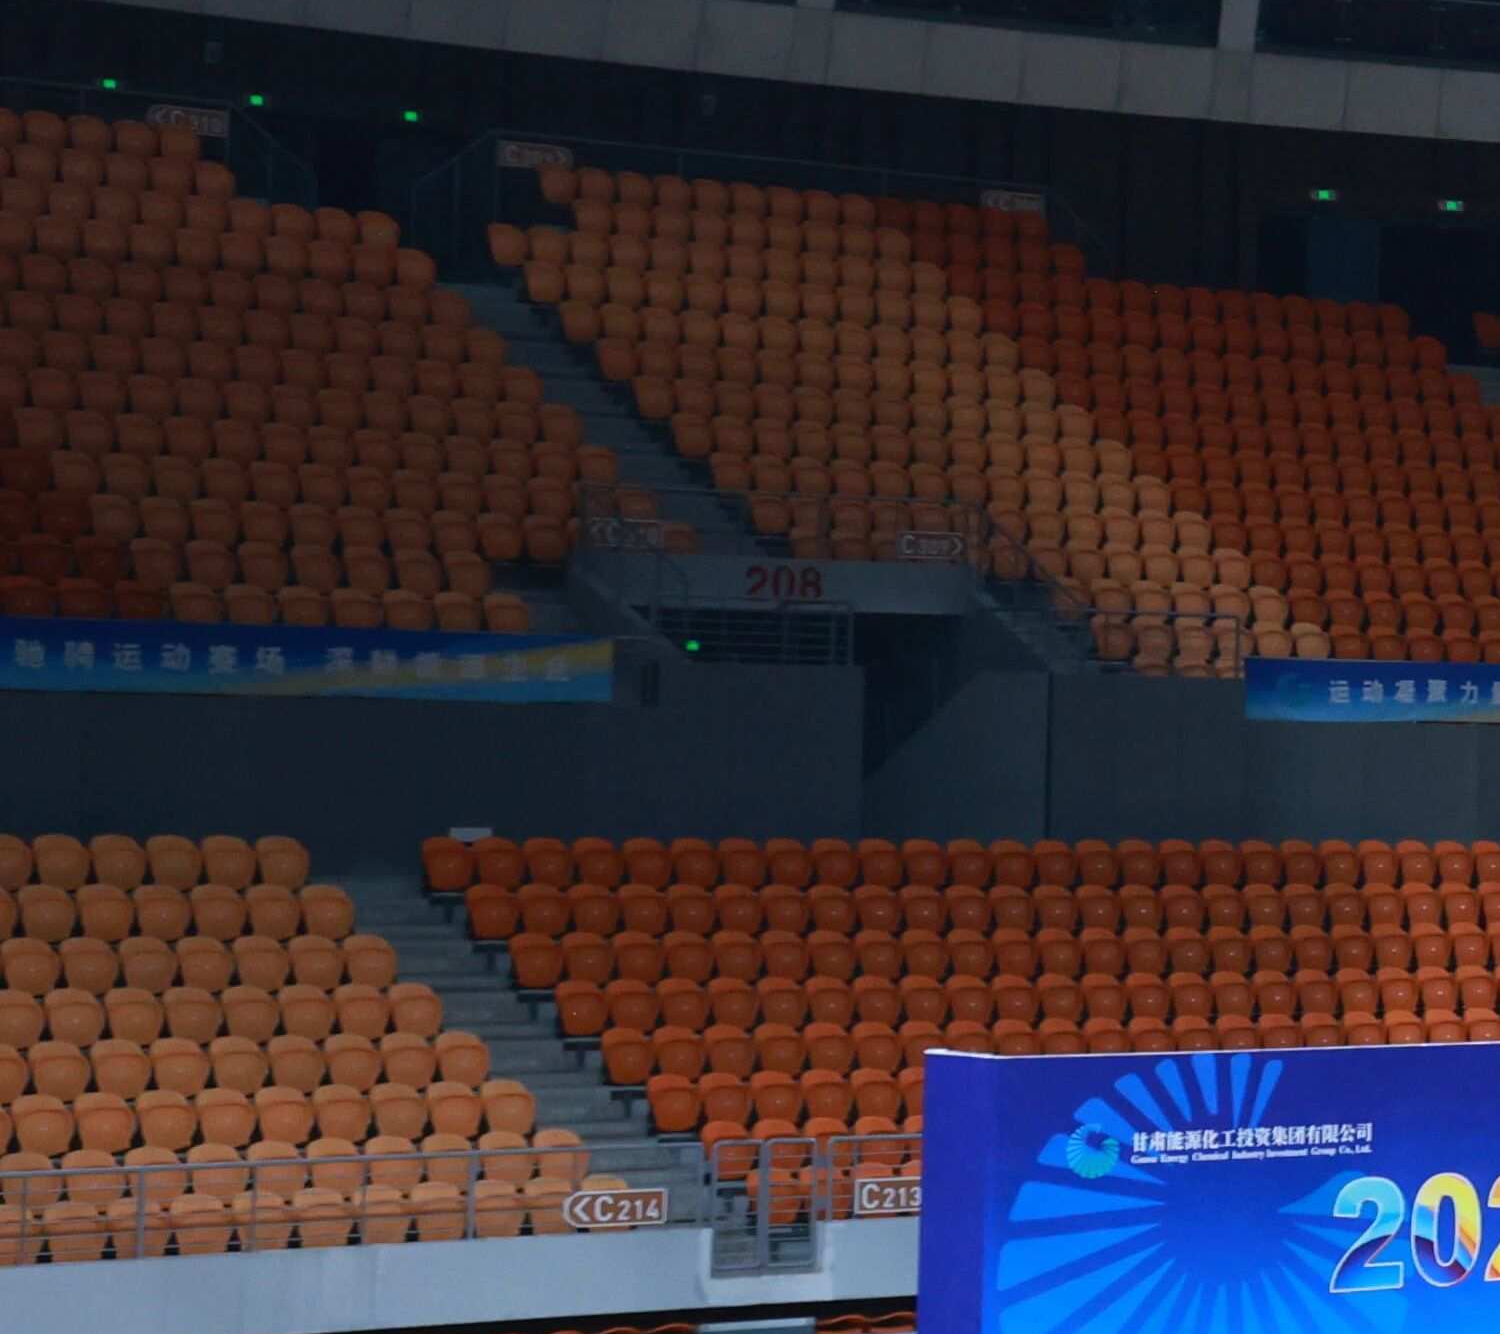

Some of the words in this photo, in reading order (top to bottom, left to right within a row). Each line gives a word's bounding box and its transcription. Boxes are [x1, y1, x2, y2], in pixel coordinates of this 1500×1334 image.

[744, 565, 823, 599] 208
[1131, 1122, 1374, 1154] 甘肃能源化工投资集团有限公司
[592, 1192, 662, 1223] C214
[860, 1181, 922, 1213] C213
